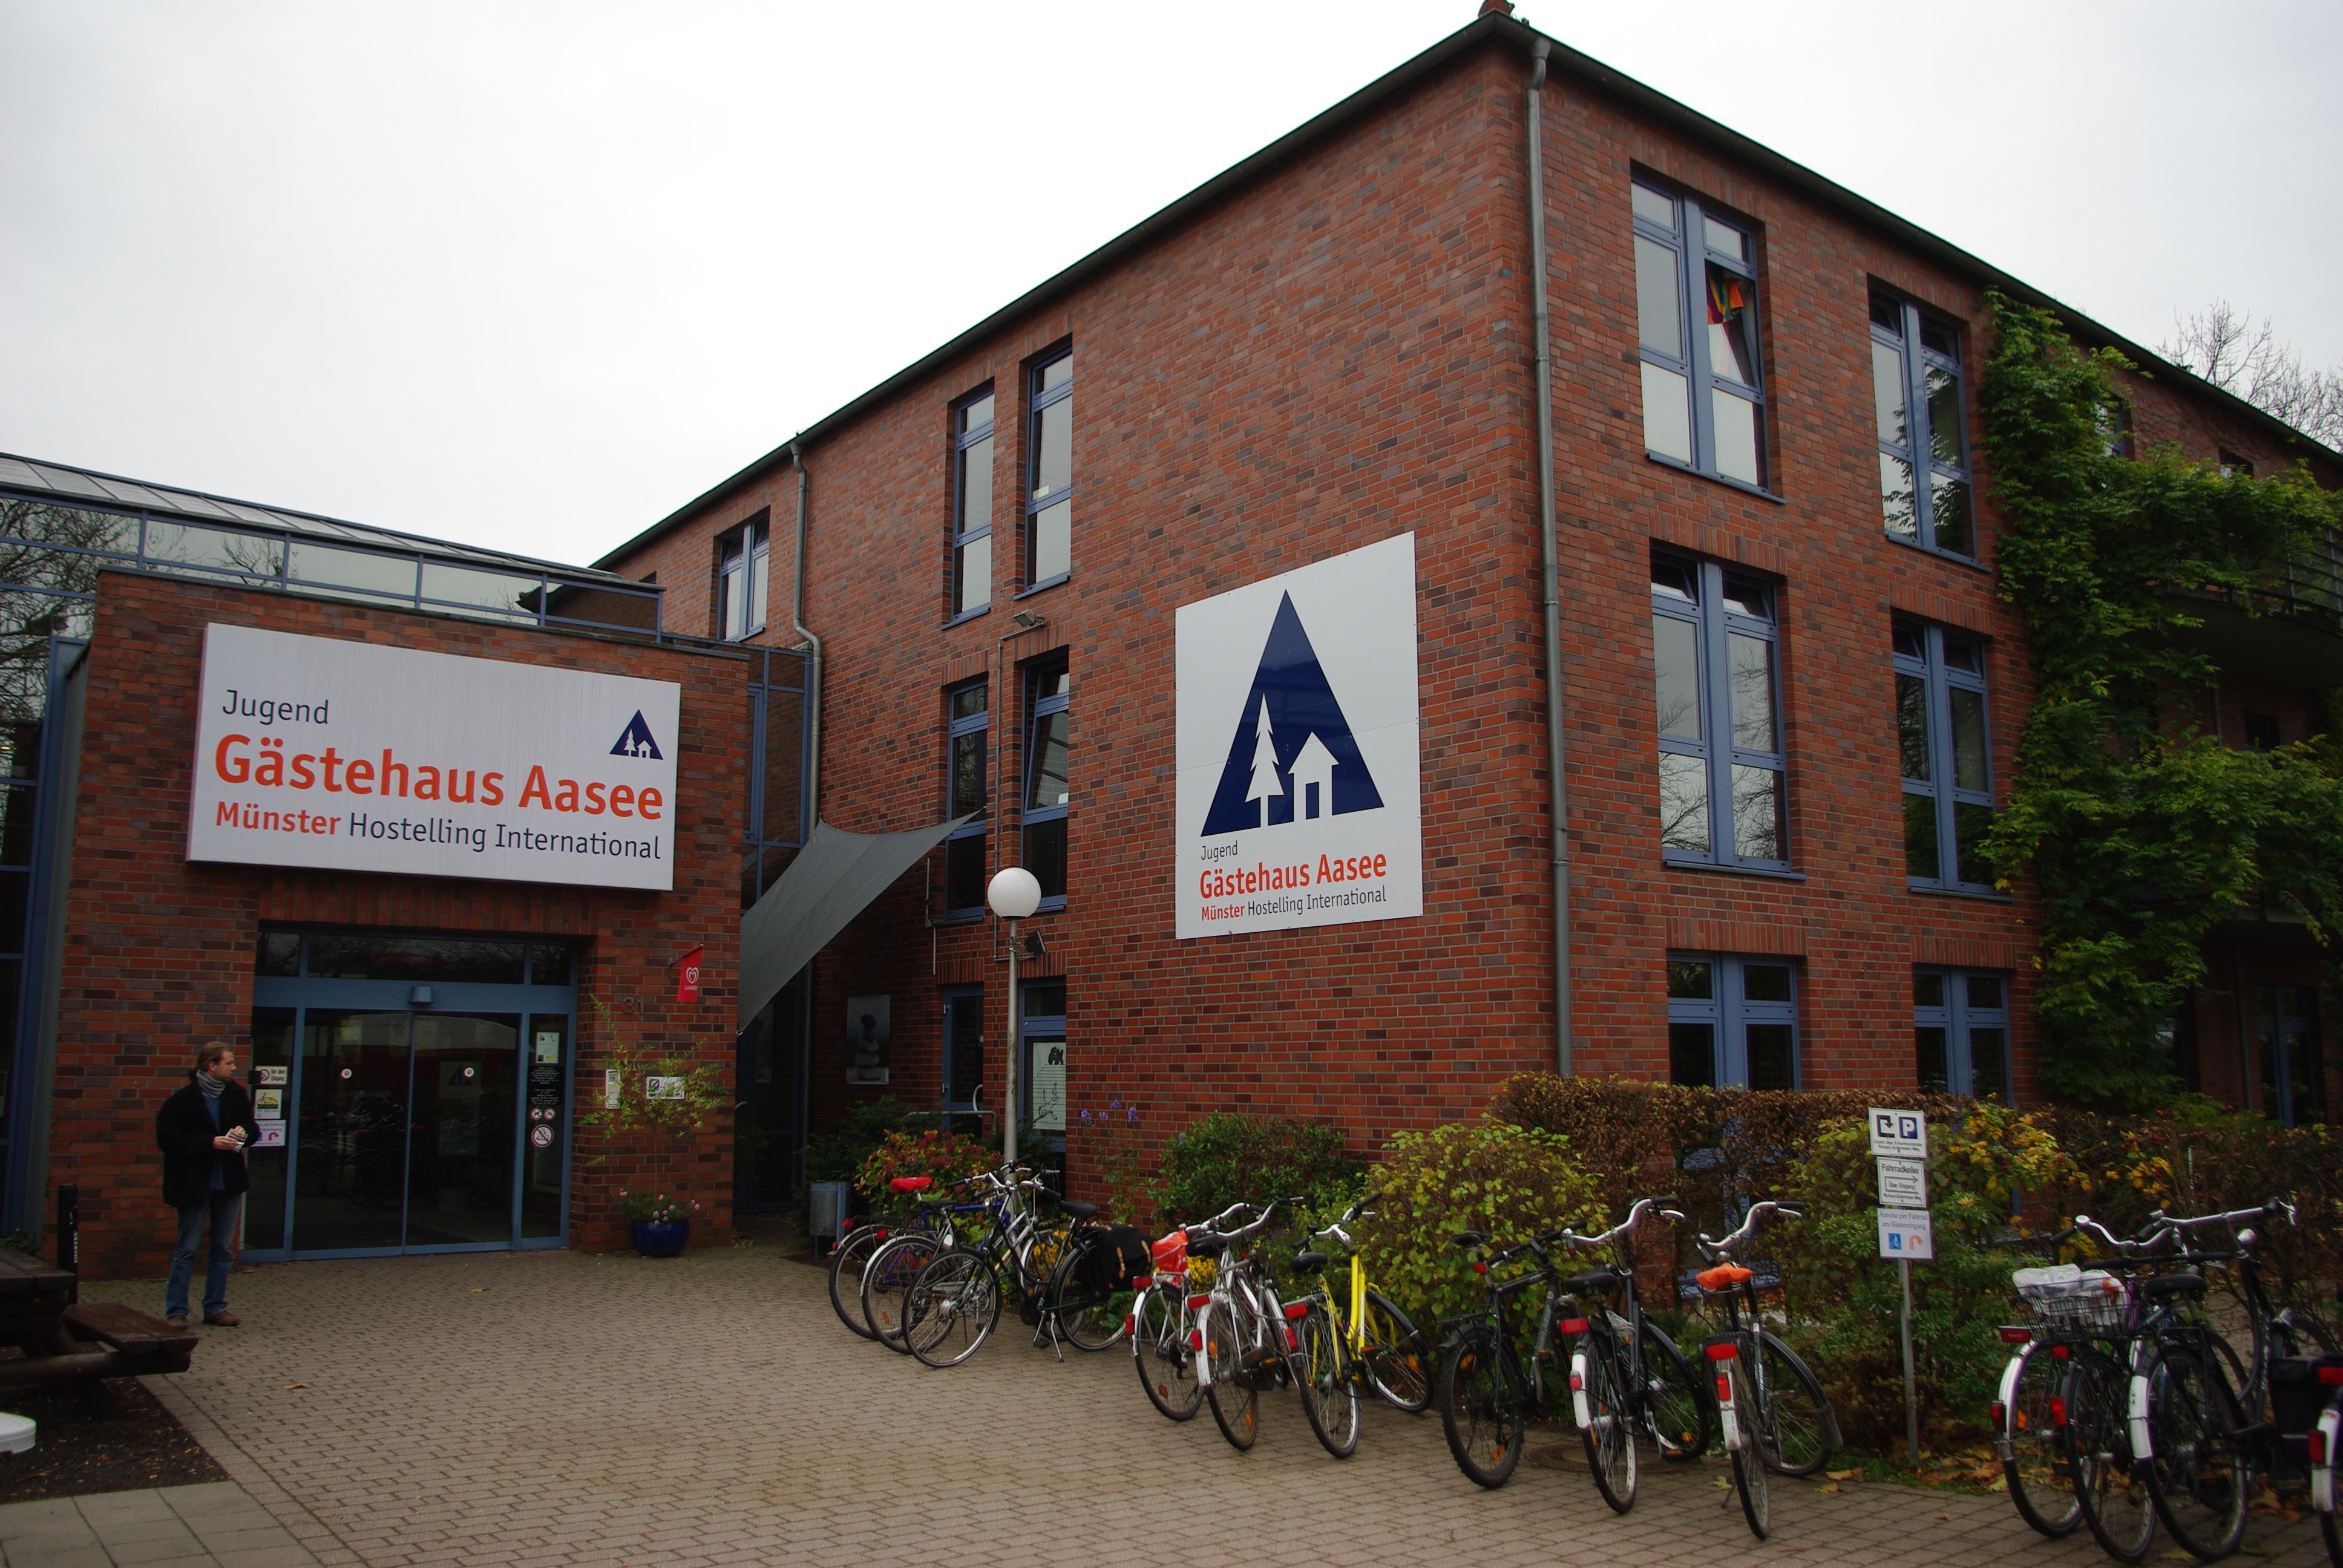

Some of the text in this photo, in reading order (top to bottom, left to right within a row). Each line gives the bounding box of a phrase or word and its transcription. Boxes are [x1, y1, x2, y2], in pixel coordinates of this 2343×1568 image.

[222, 689, 329, 725] Jugend
[215, 734, 663, 820] Gästehaus Aasee
[216, 801, 661, 860] Münster Hostelling International
[1201, 840, 1238, 863] Jugend
[1200, 853, 1387, 900] Gästehaus Aasee
[1202, 884, 1387, 921] Münster Hostelling International
[623, 997, 644, 1014] 31
[1881, 1163, 1919, 1174] Fahrradkeller
[1891, 1221, 1927, 1230] Hintereingang
